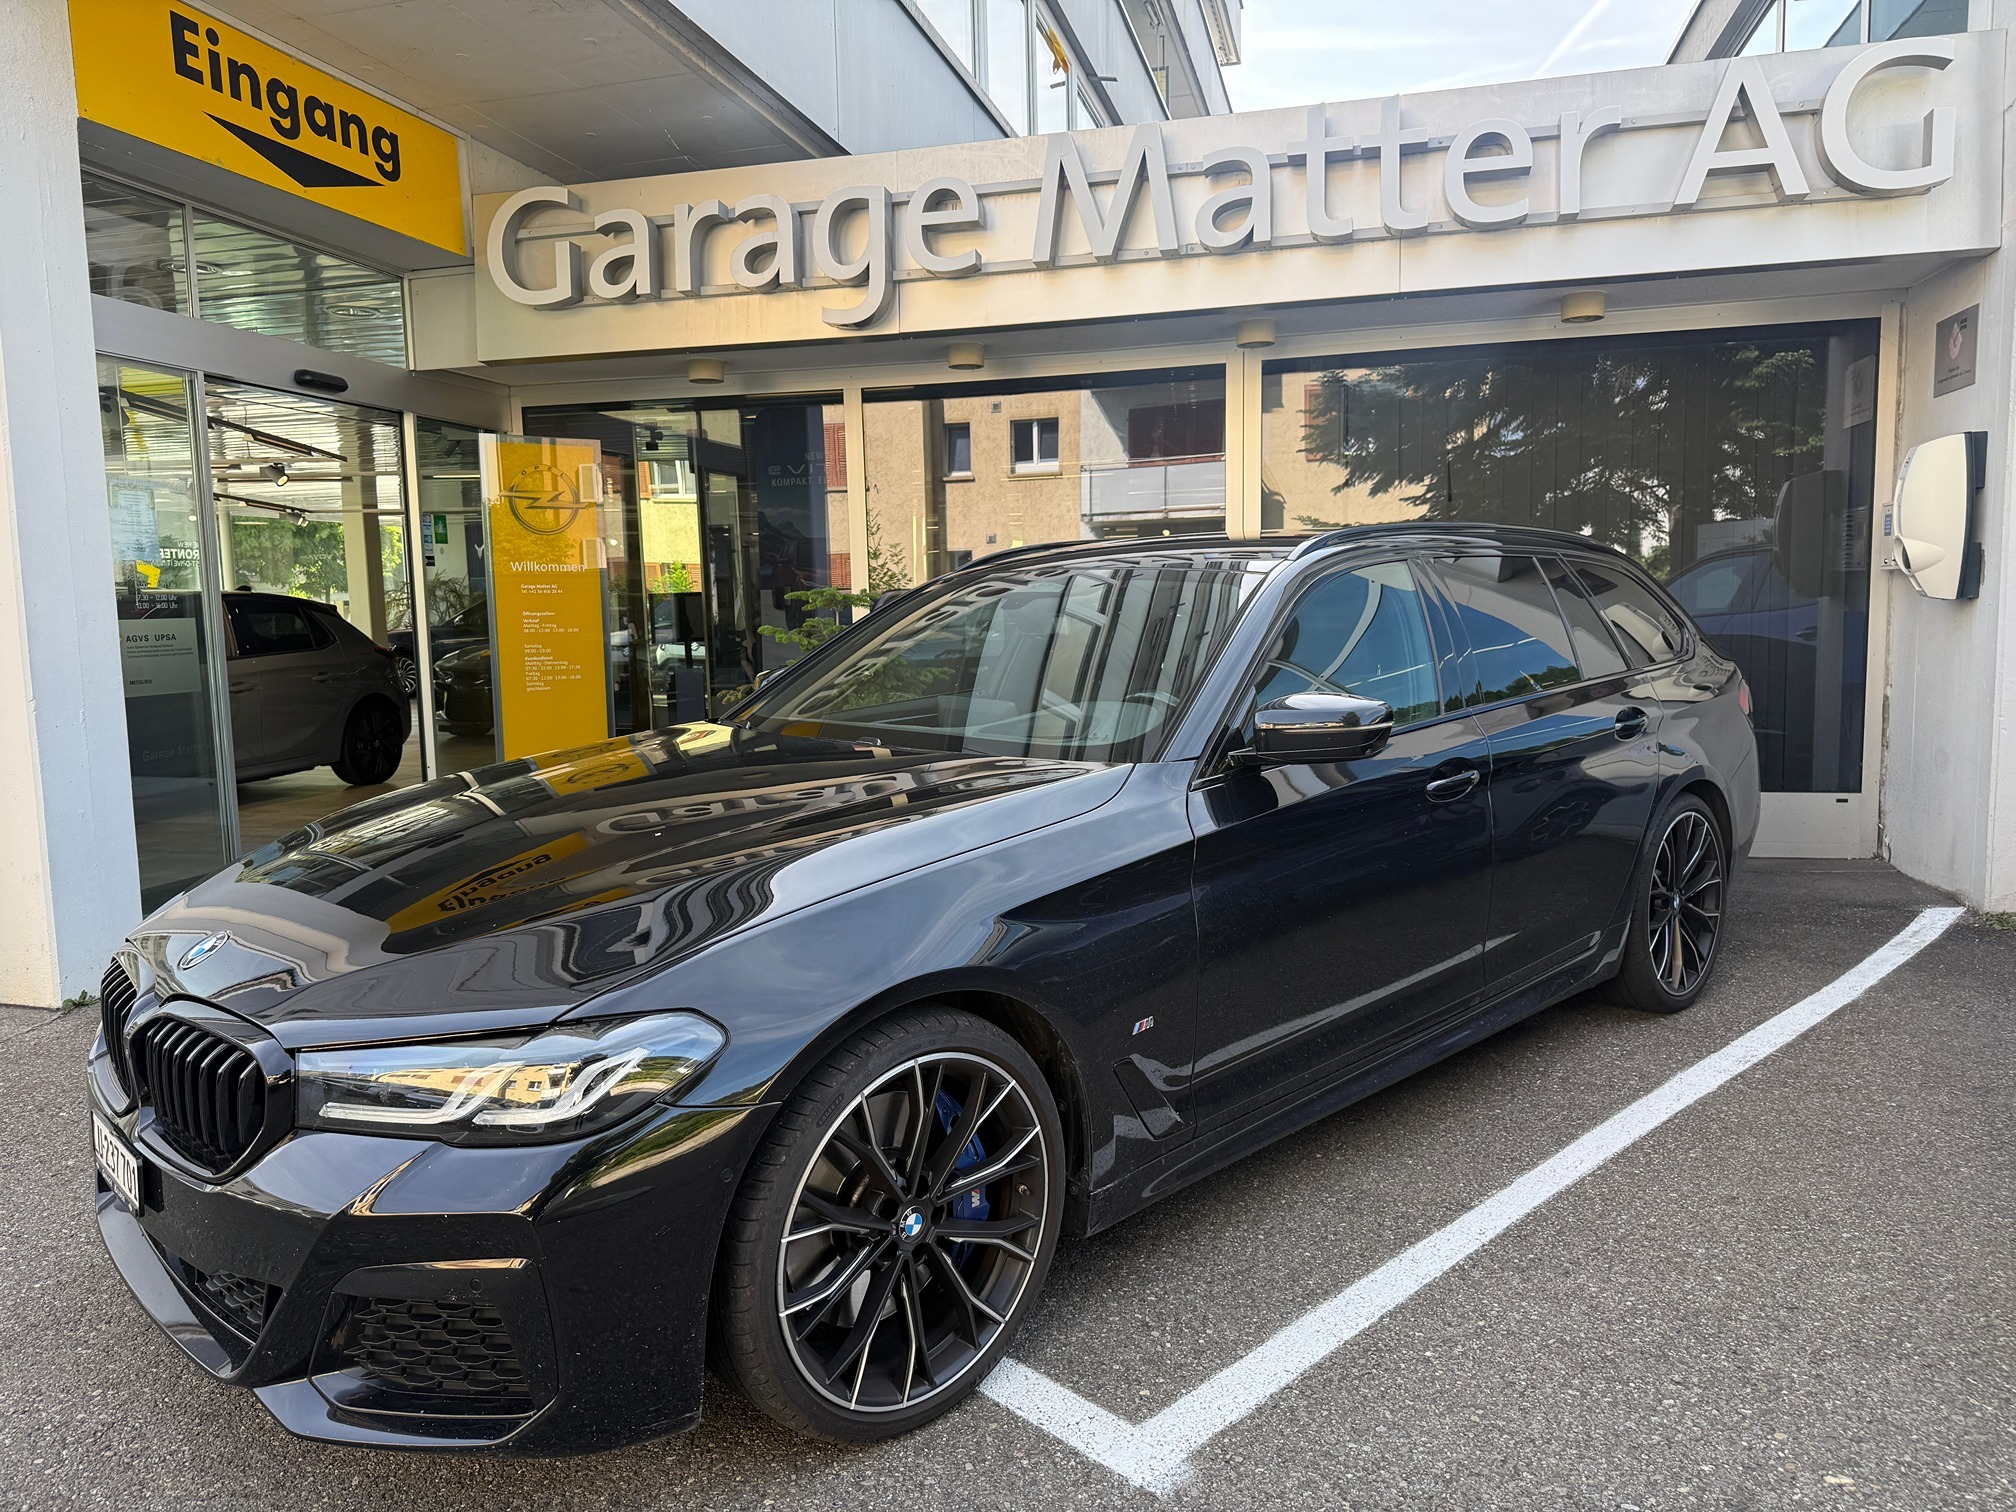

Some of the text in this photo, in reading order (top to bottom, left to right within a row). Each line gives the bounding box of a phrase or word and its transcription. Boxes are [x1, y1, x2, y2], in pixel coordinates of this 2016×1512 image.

[169, 10, 401, 182] Eingang
[486, 36, 1956, 330] Garage Matter AG
[521, 465, 565, 479] OPEL
[510, 560, 586, 572] Willkommen
[126, 633, 177, 643] AGVS UPSA
